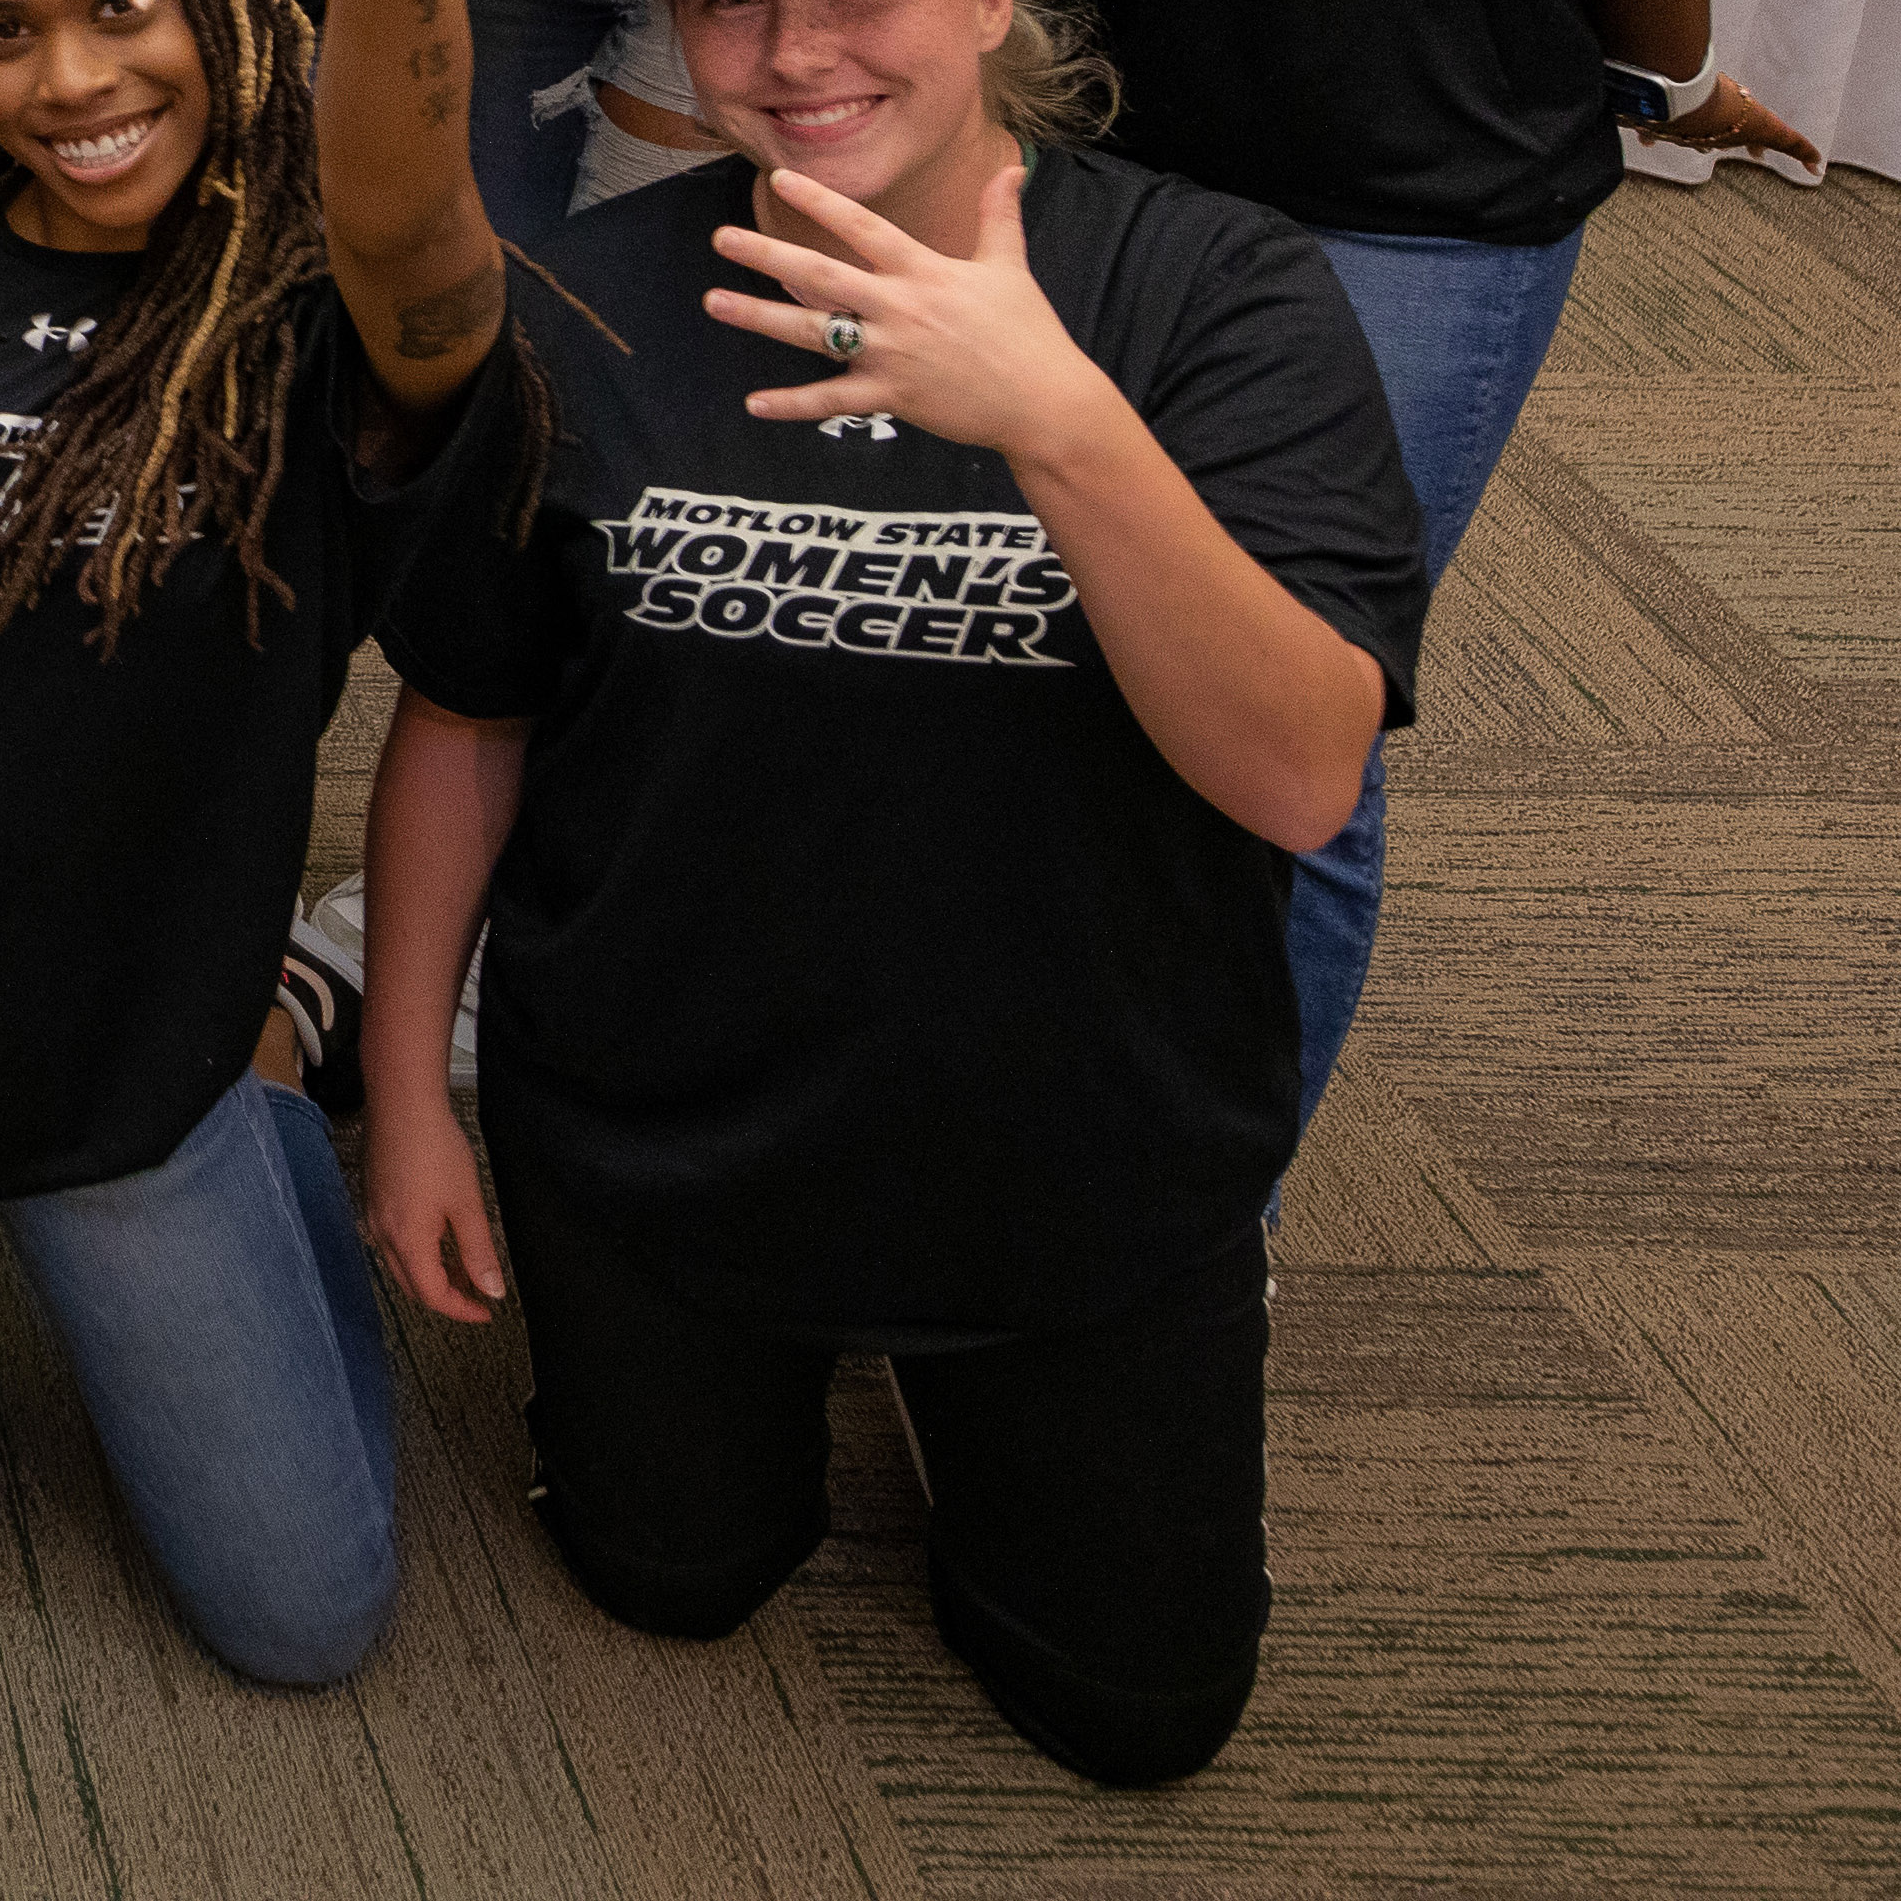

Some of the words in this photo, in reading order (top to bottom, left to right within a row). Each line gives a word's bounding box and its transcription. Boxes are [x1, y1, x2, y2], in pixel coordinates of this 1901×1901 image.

[591, 520, 1078, 612] WOMEN'S
[640, 497, 867, 542] MOTLOW
[875, 521, 1041, 548] STATE
[623, 573, 1077, 667] SOCCER
